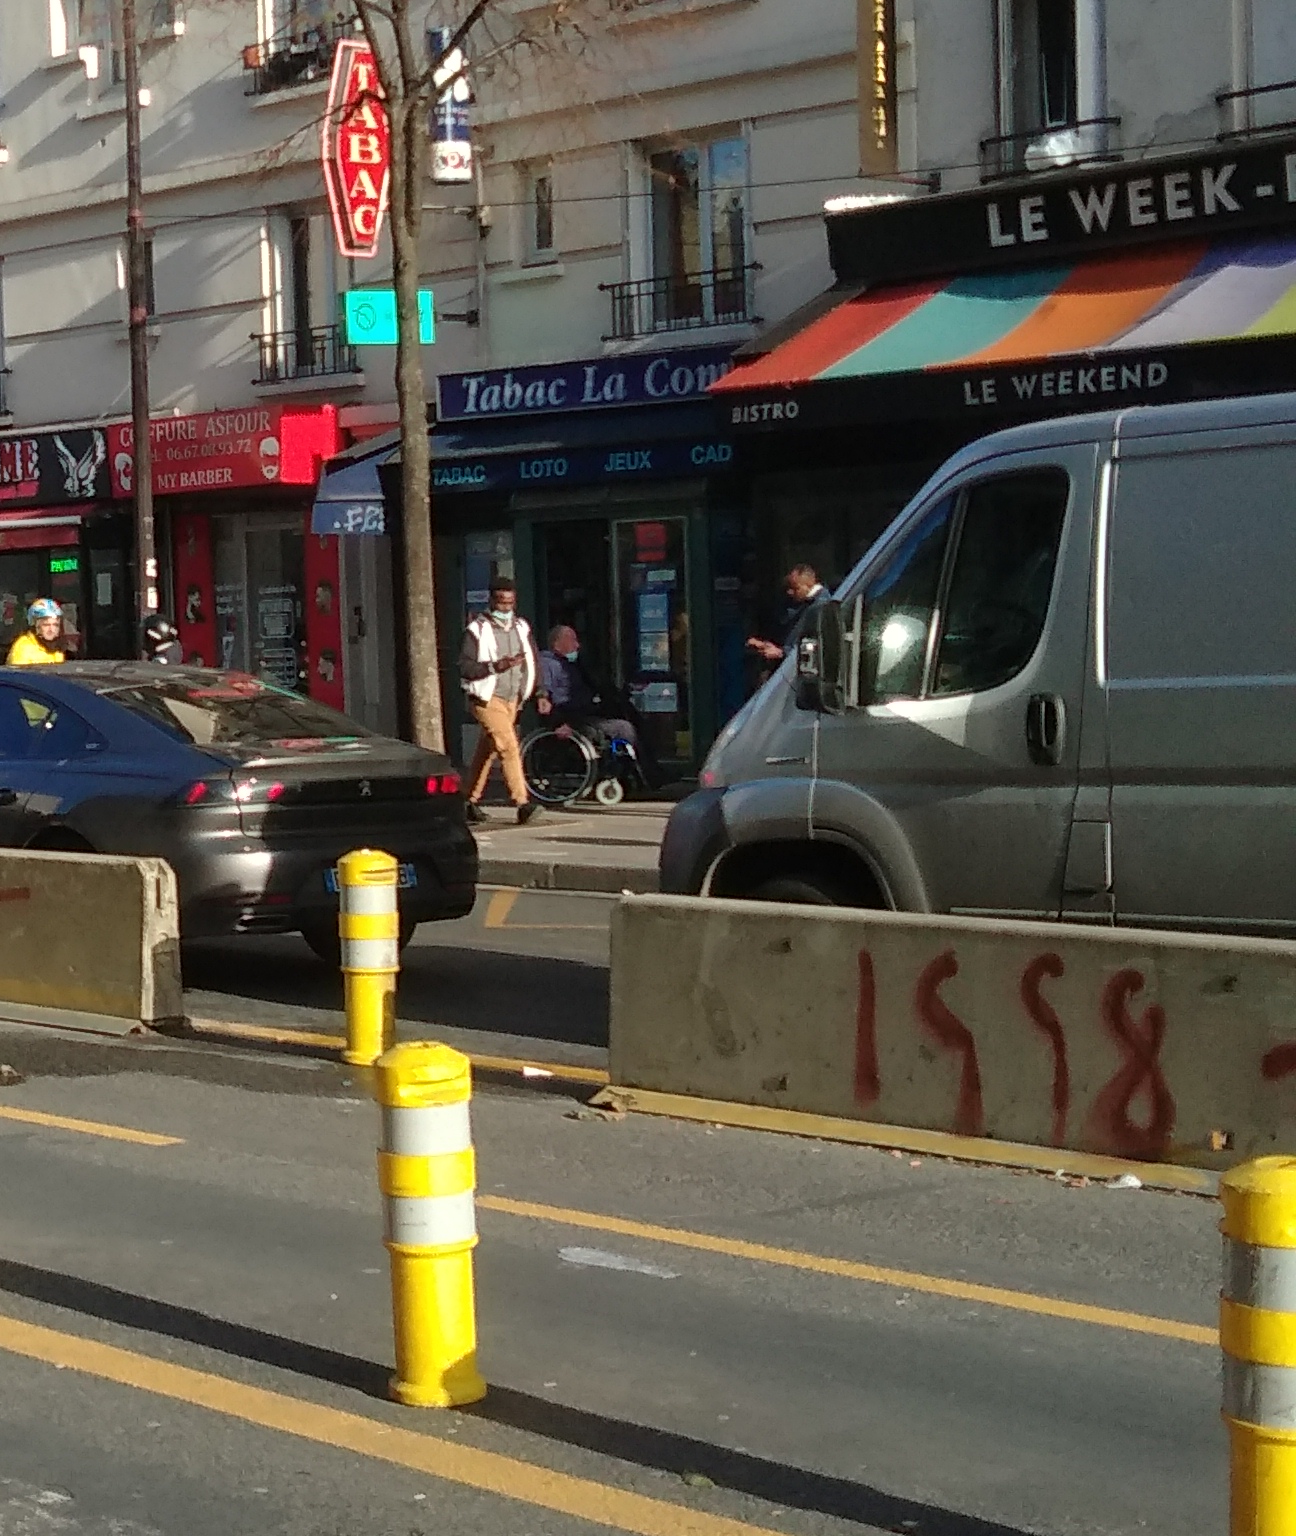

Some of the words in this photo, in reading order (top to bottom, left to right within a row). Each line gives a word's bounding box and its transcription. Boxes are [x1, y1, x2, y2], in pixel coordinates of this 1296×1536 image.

[348, 62, 382, 234] TABAC
[986, 195, 1050, 248] LE
[461, 373, 567, 414] Tabac
[580, 364, 628, 403] La
[963, 379, 997, 406] LE
[1012, 362, 1169, 400] WEEKEND
[205, 411, 271, 438] ASFOUR
[731, 401, 799, 424] BISTRO
[157, 473, 178, 489] MY
[180, 467, 233, 486] BARBER
[432, 464, 487, 487] TABAC
[520, 458, 570, 479] LOTO
[604, 450, 653, 472] JEUX
